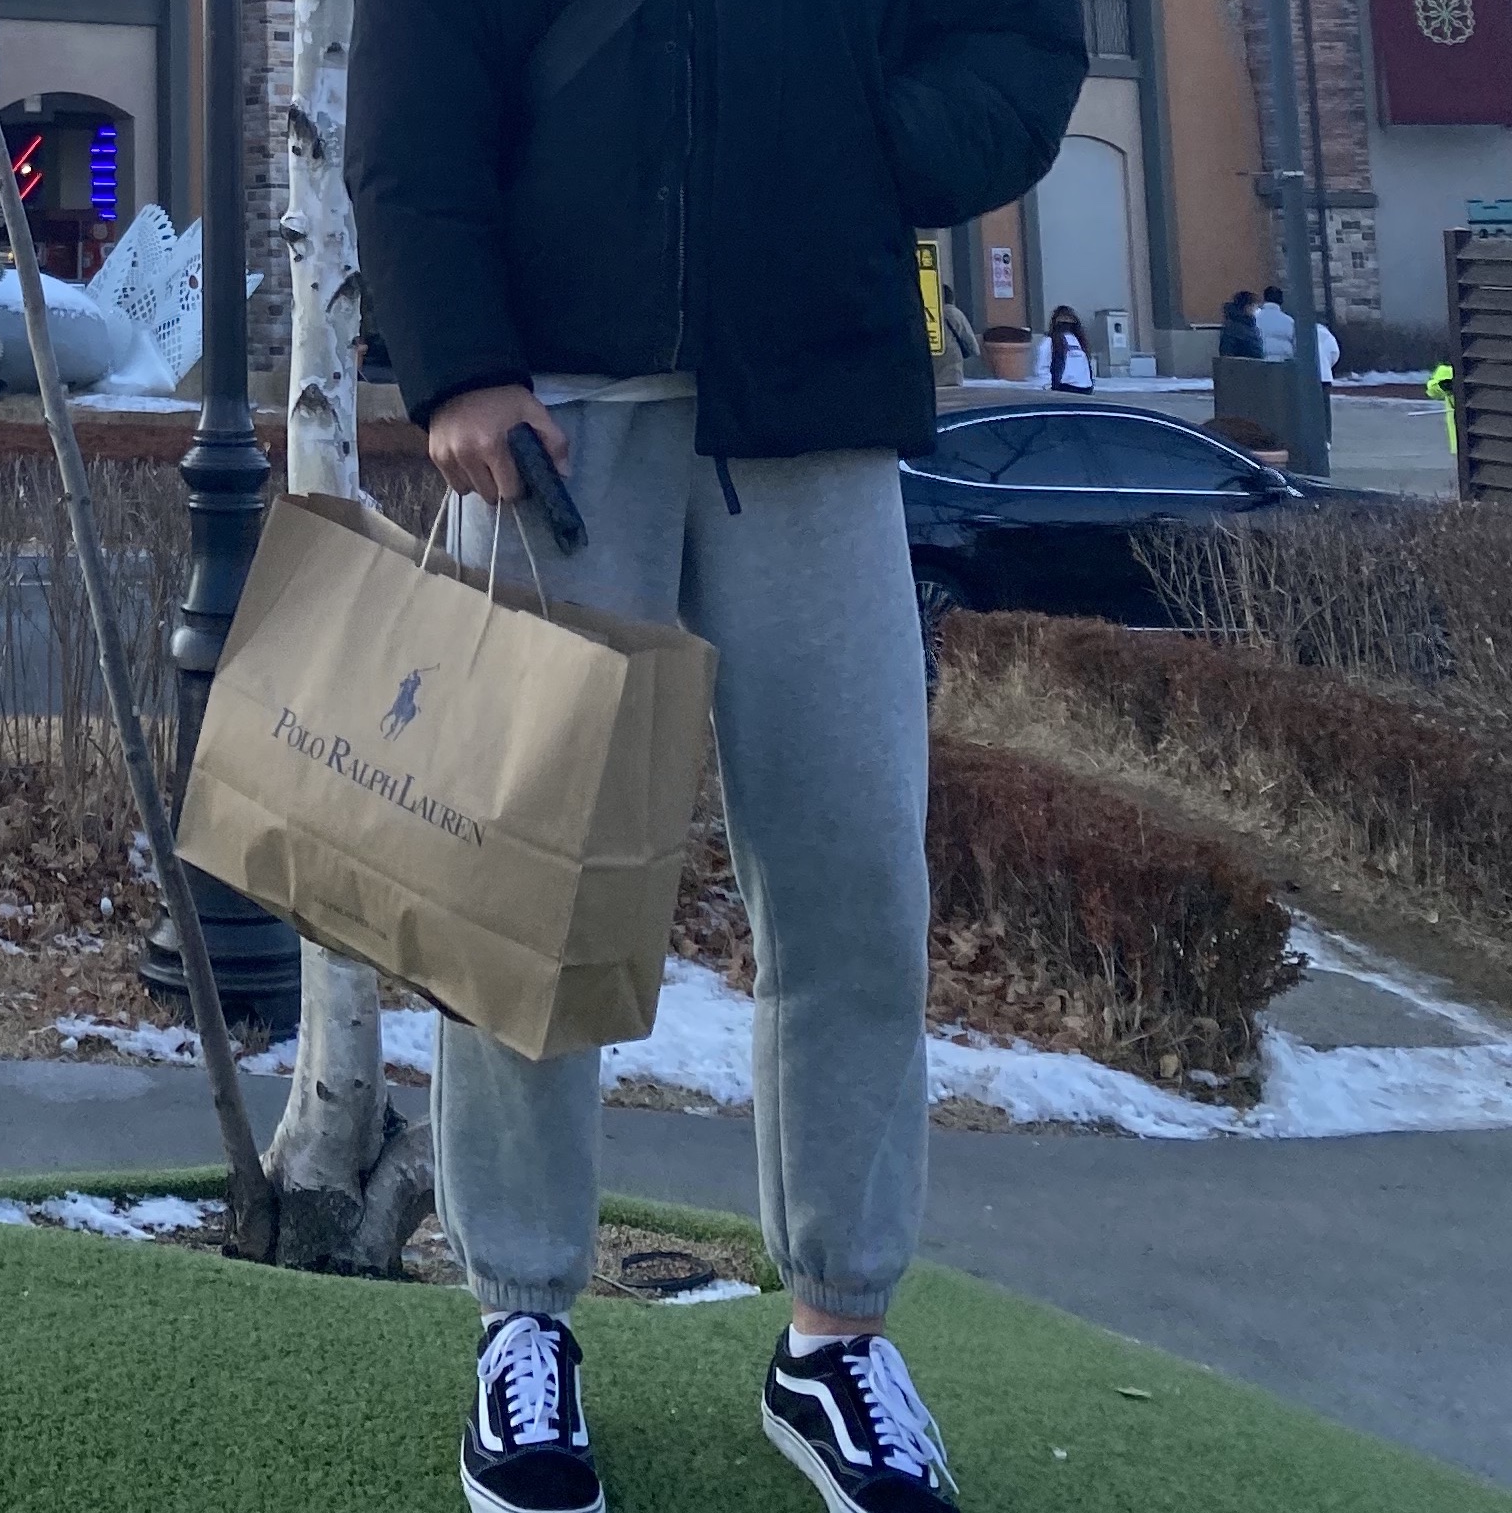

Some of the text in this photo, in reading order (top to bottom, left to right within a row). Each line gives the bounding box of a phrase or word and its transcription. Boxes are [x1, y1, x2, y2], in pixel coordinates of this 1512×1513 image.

[271, 706, 487, 848] POLO RALPH LAUREN
